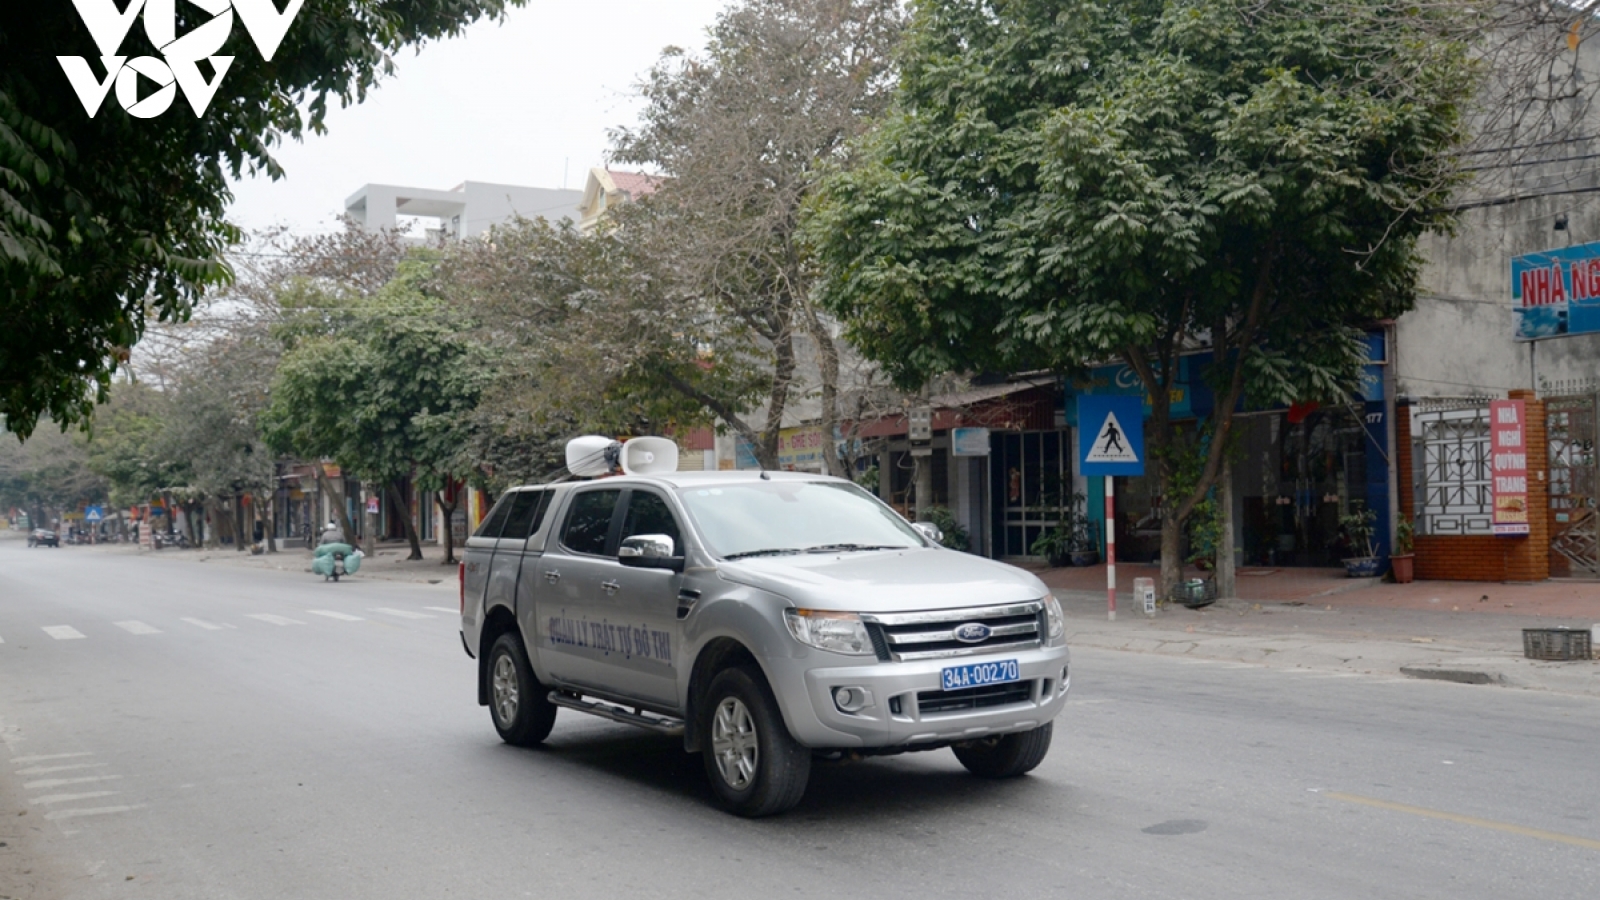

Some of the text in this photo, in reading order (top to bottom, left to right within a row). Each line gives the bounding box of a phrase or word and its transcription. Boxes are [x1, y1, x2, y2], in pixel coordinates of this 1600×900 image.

[1521, 256, 1566, 308] NHÀ
[1365, 412, 1383, 424] 177
[1498, 403, 1518, 424] NHÀ
[1498, 424, 1521, 447] NGHỈ
[1495, 450, 1526, 471] QUỲNH
[1495, 476, 1526, 493] TRANG
[549, 608, 672, 667] QUẢN LÝ TRẬT TỰ ĐÔ THỊ
[963, 626, 985, 638] Ford
